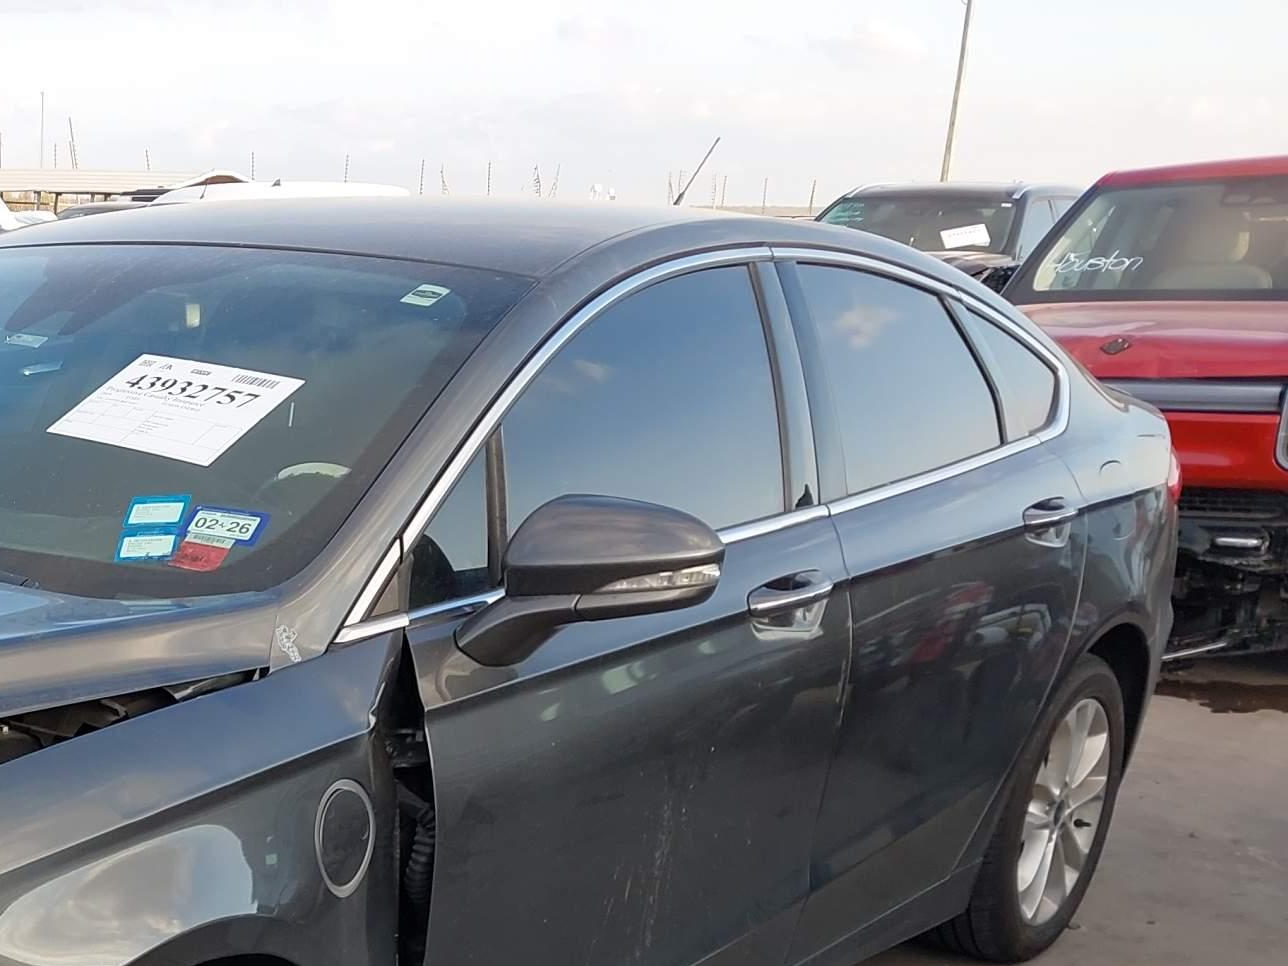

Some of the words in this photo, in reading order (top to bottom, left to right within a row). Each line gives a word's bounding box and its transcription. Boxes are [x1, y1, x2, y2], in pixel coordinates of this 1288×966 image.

[124, 374, 261, 408] 43932757
[194, 516, 220, 530] 02
[225, 521, 252, 535] 26
